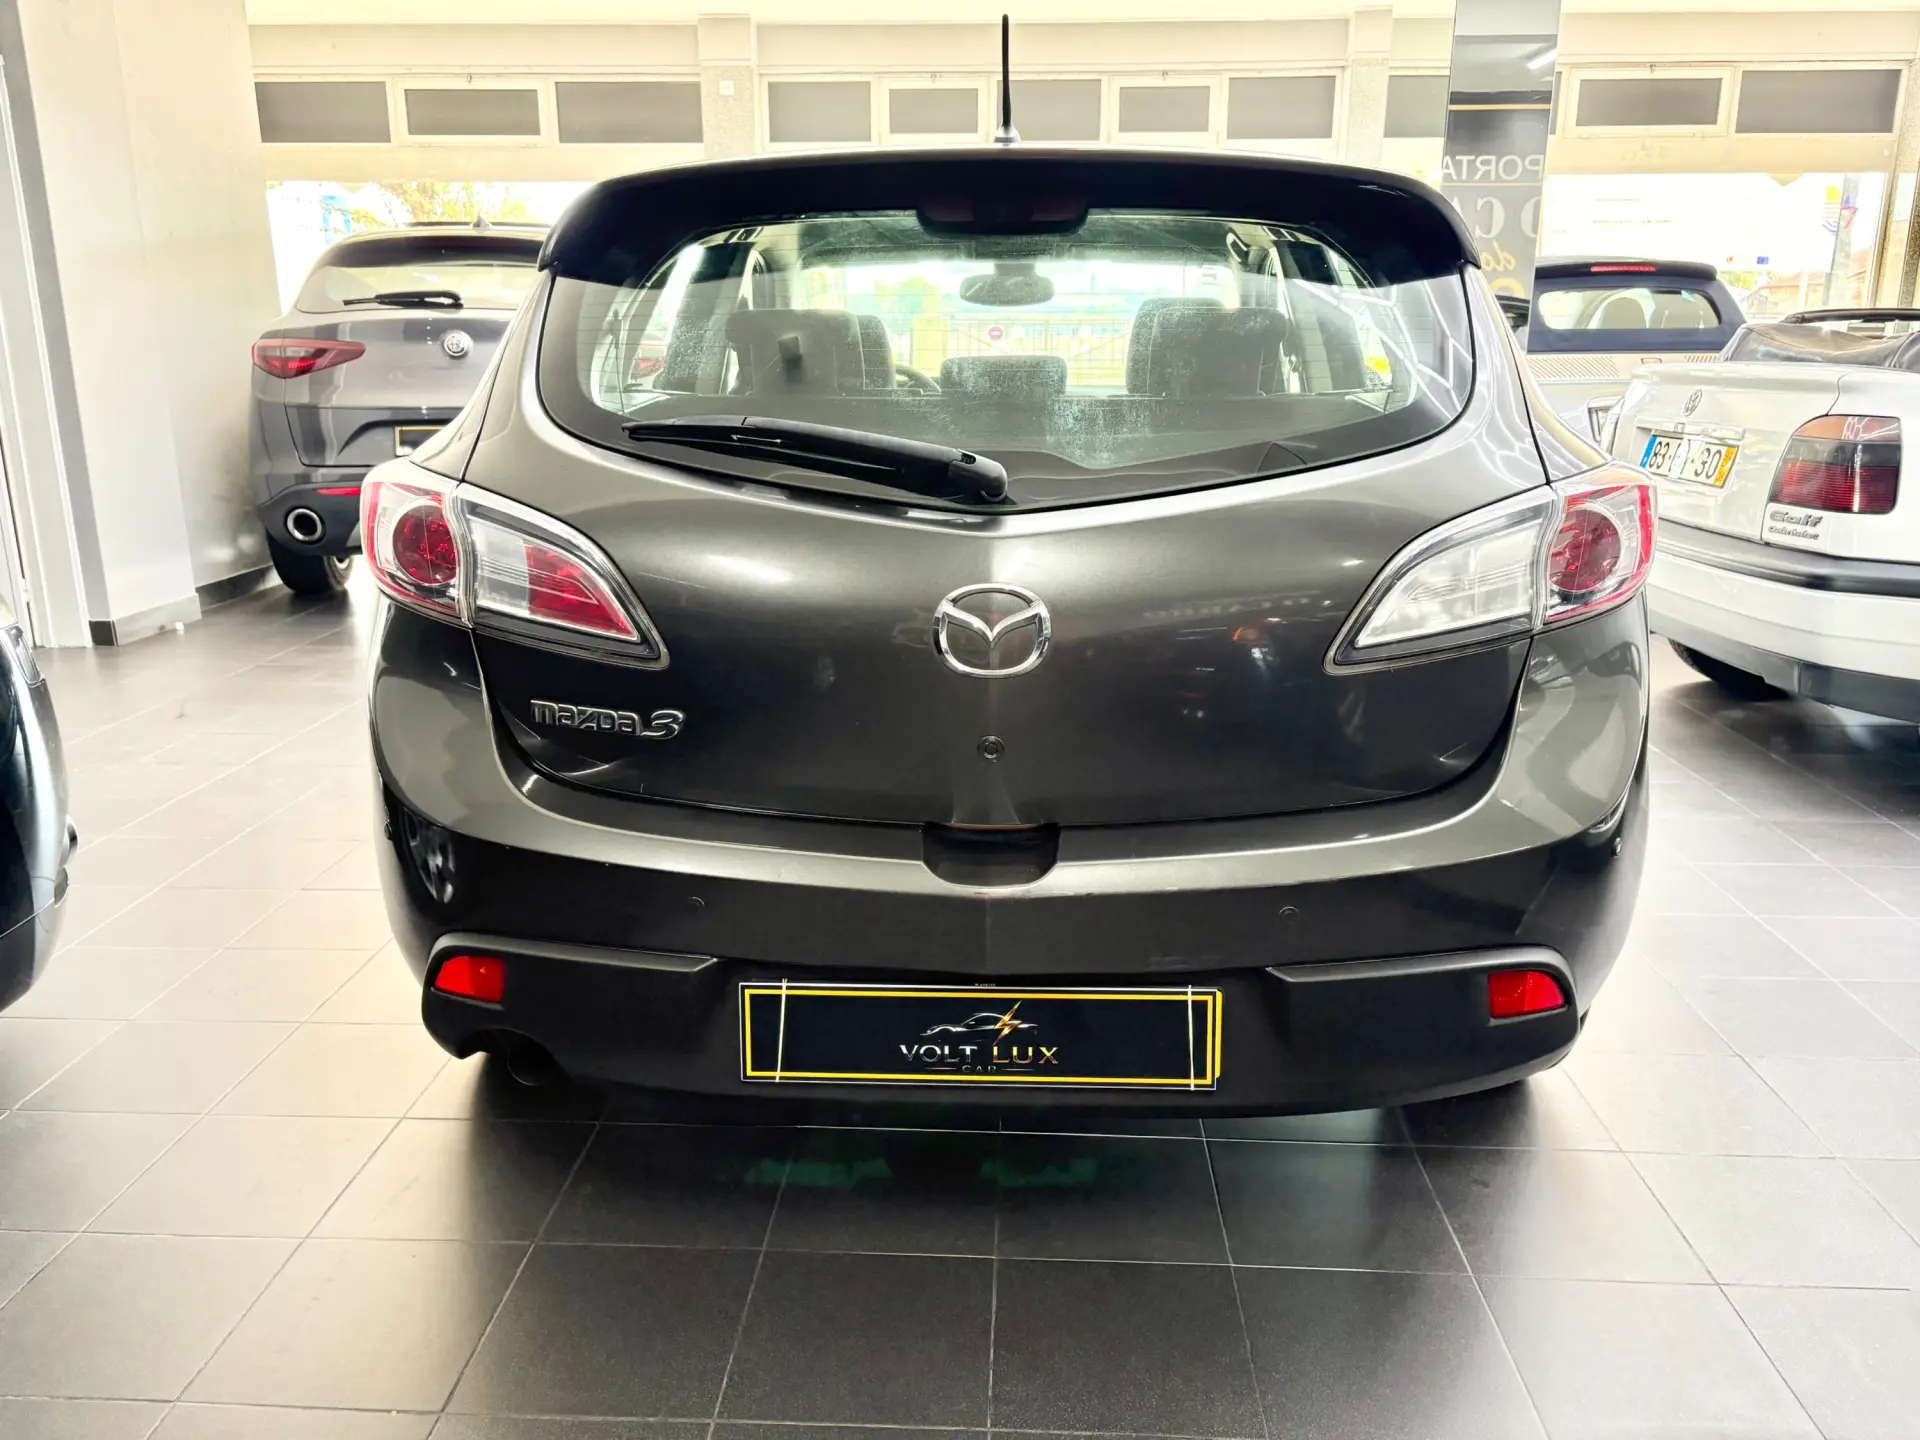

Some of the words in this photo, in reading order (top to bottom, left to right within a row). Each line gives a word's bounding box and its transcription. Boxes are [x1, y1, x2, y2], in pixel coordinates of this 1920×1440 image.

[899, 1044, 978, 1062] VOLT
[992, 1045, 1059, 1064] LUX
[961, 1064, 998, 1074] CAR
